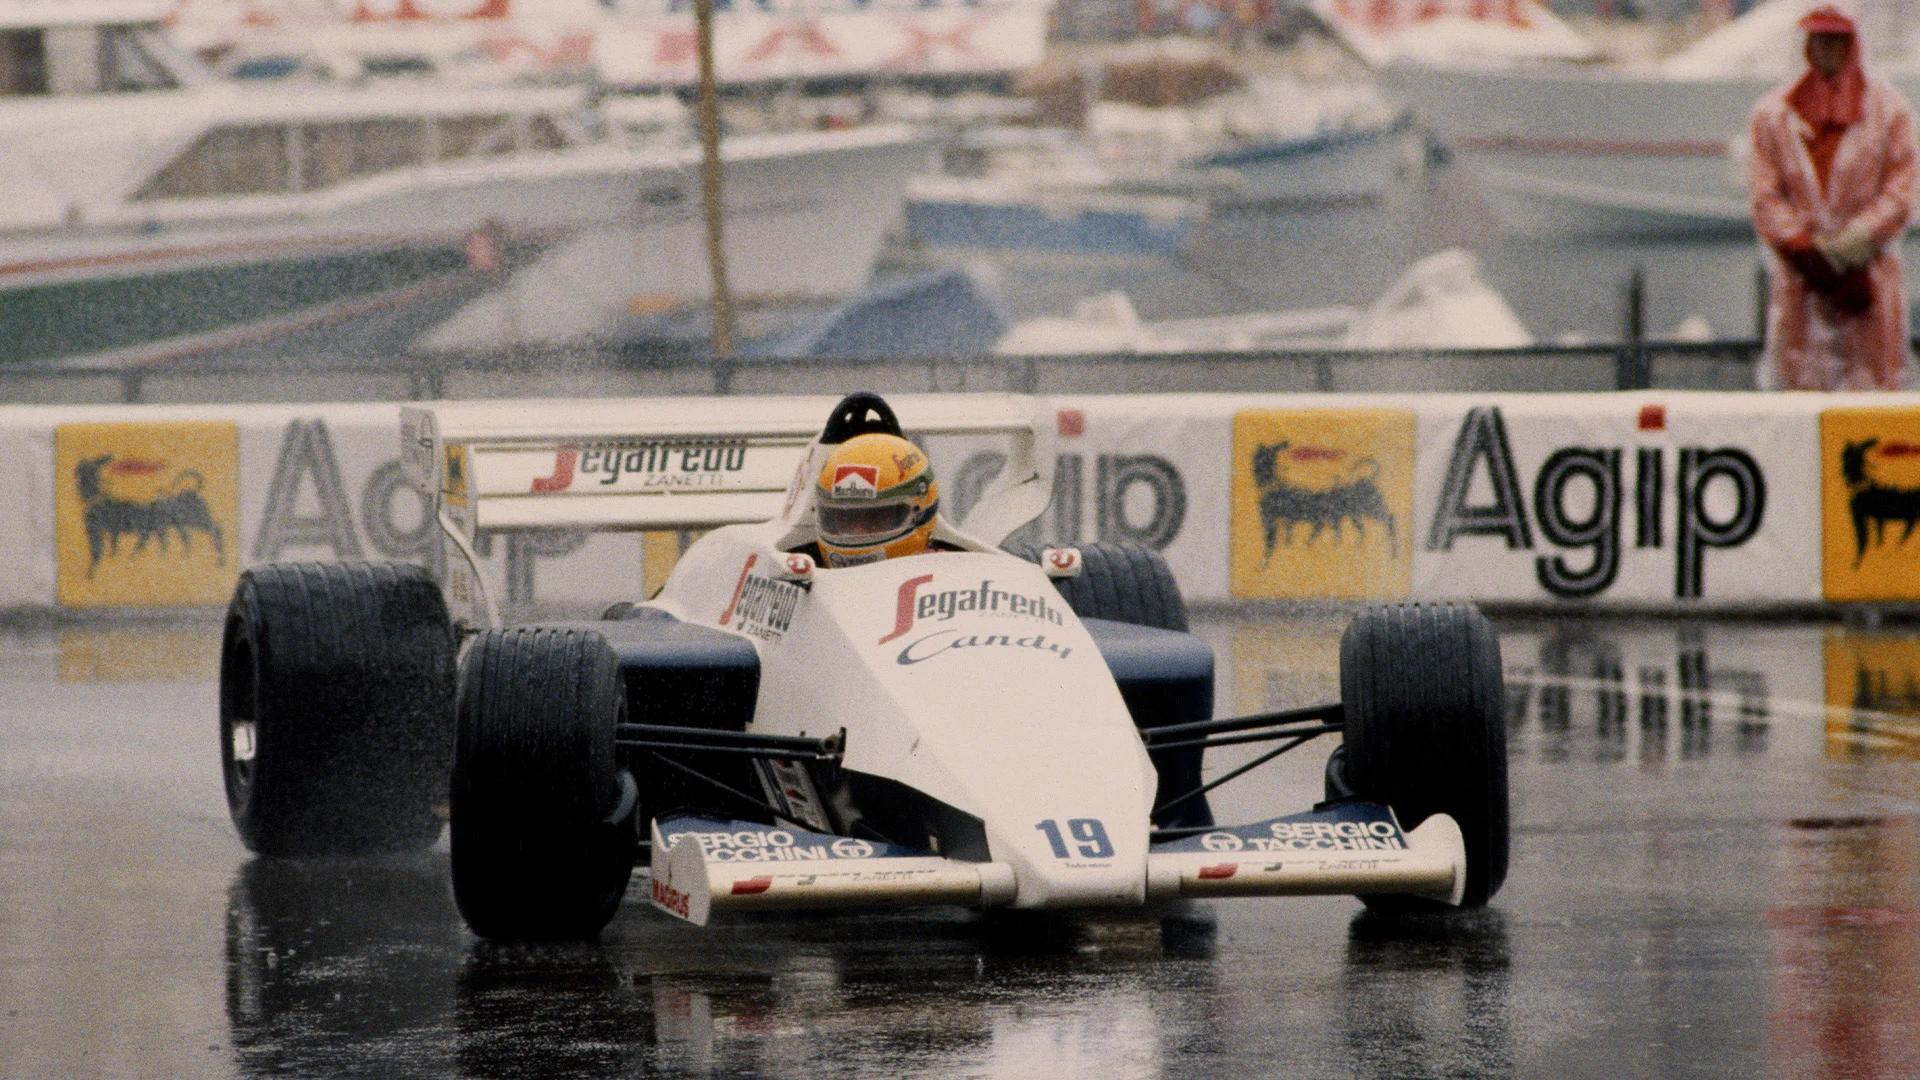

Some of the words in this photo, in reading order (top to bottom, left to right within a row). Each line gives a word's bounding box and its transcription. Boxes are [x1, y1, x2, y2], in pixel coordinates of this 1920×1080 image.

[644, 474, 724, 487] ZANETTI
[1426, 405, 1767, 598] Agip
[878, 574, 1063, 645] Segafredo
[897, 628, 1073, 665] Candy
[1035, 818, 1115, 859] 19
[1247, 836, 1403, 850] TACCHINI
[1270, 821, 1395, 839] SERGIO
[704, 846, 829, 862] CCHINI
